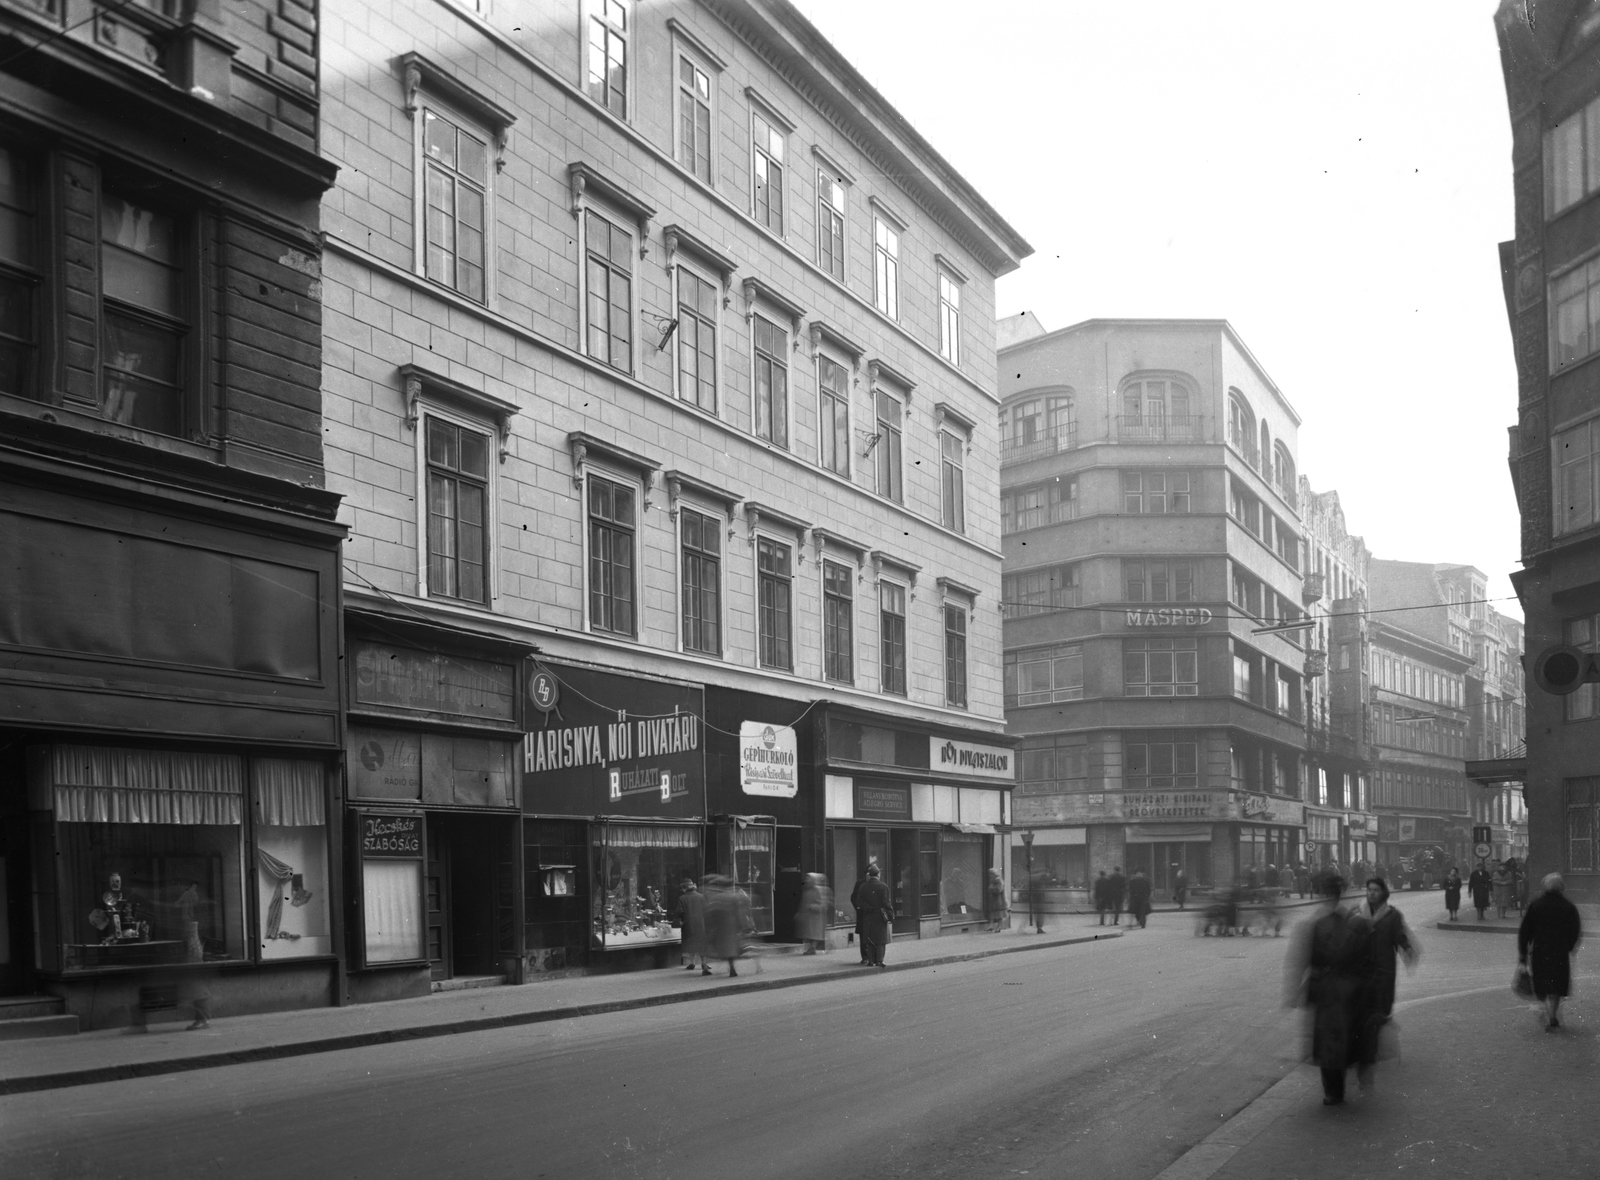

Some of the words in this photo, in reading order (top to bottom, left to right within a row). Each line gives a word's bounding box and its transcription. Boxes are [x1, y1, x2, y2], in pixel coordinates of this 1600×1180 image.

[1126, 608, 1212, 626] MASPED
[524, 725, 606, 773] HARISNYA,
[608, 709, 632, 762] NŐI
[638, 705, 698, 758] DIVATÁRU
[941, 741, 957, 766] NŐI
[960, 749, 1008, 771] DIVATSZALON
[384, 774, 407, 787] RÁDIÓ
[610, 765, 658, 798] RUHÁZATI
[660, 772, 687, 800] BOLT
[884, 800, 903, 809] SERVICE
[1174, 794, 1211, 804] KISIPARI
[365, 817, 416, 837] Kecskés
[363, 836, 419, 851] SZABÓSÁG
